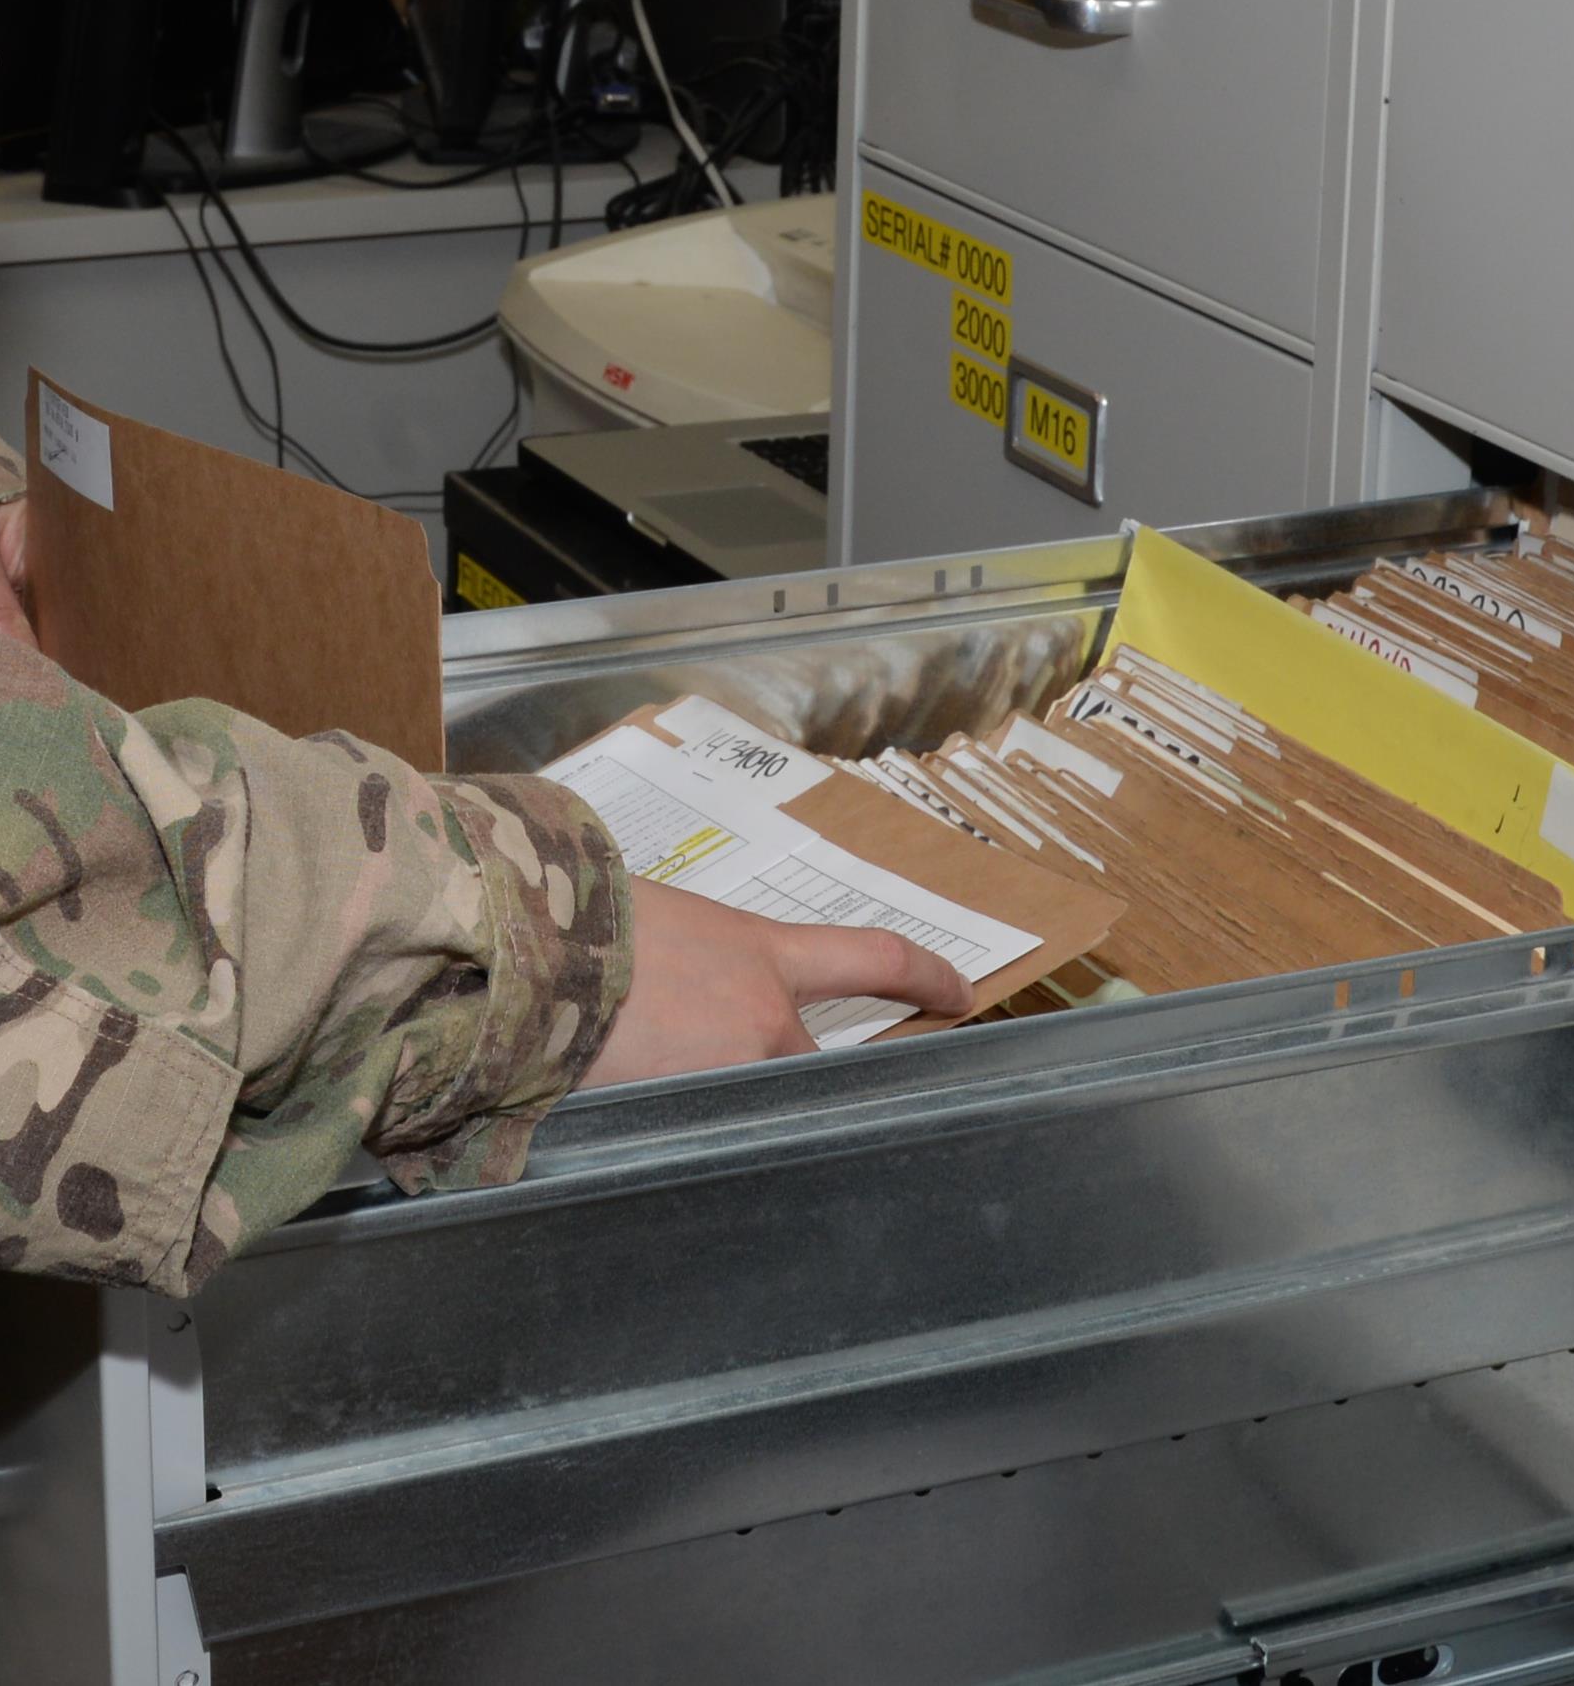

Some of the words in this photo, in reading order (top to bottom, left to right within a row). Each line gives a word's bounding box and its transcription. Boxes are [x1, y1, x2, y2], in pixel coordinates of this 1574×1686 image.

[865, 196, 952, 270] SERIAL#
[957, 239, 1007, 297] 0000
[956, 299, 1007, 359] 2000
[954, 360, 1005, 419] 3000
[1030, 396, 1076, 459] M16
